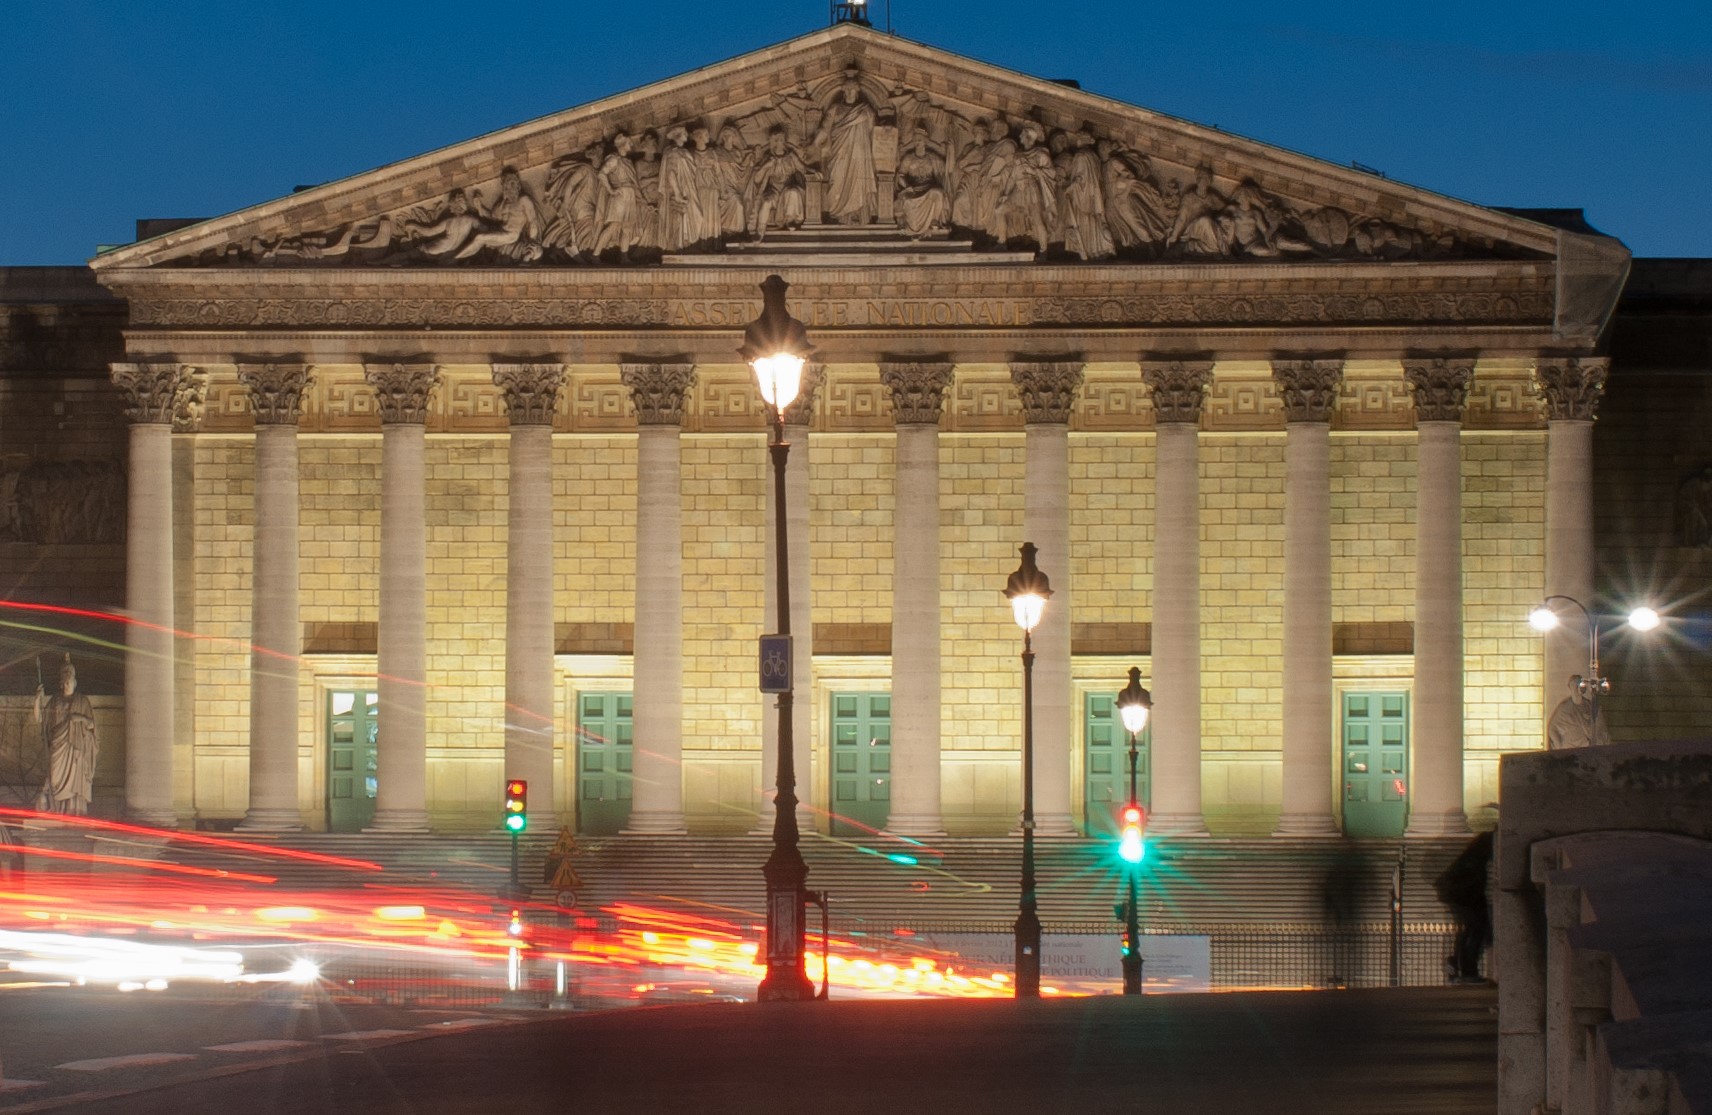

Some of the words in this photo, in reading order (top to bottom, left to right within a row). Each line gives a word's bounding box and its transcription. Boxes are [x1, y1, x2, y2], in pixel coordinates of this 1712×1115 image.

[672, 301, 849, 326] ASSELEE
[866, 301, 1030, 326] NATIONALE
[1040, 954, 1087, 966] THIQUE
